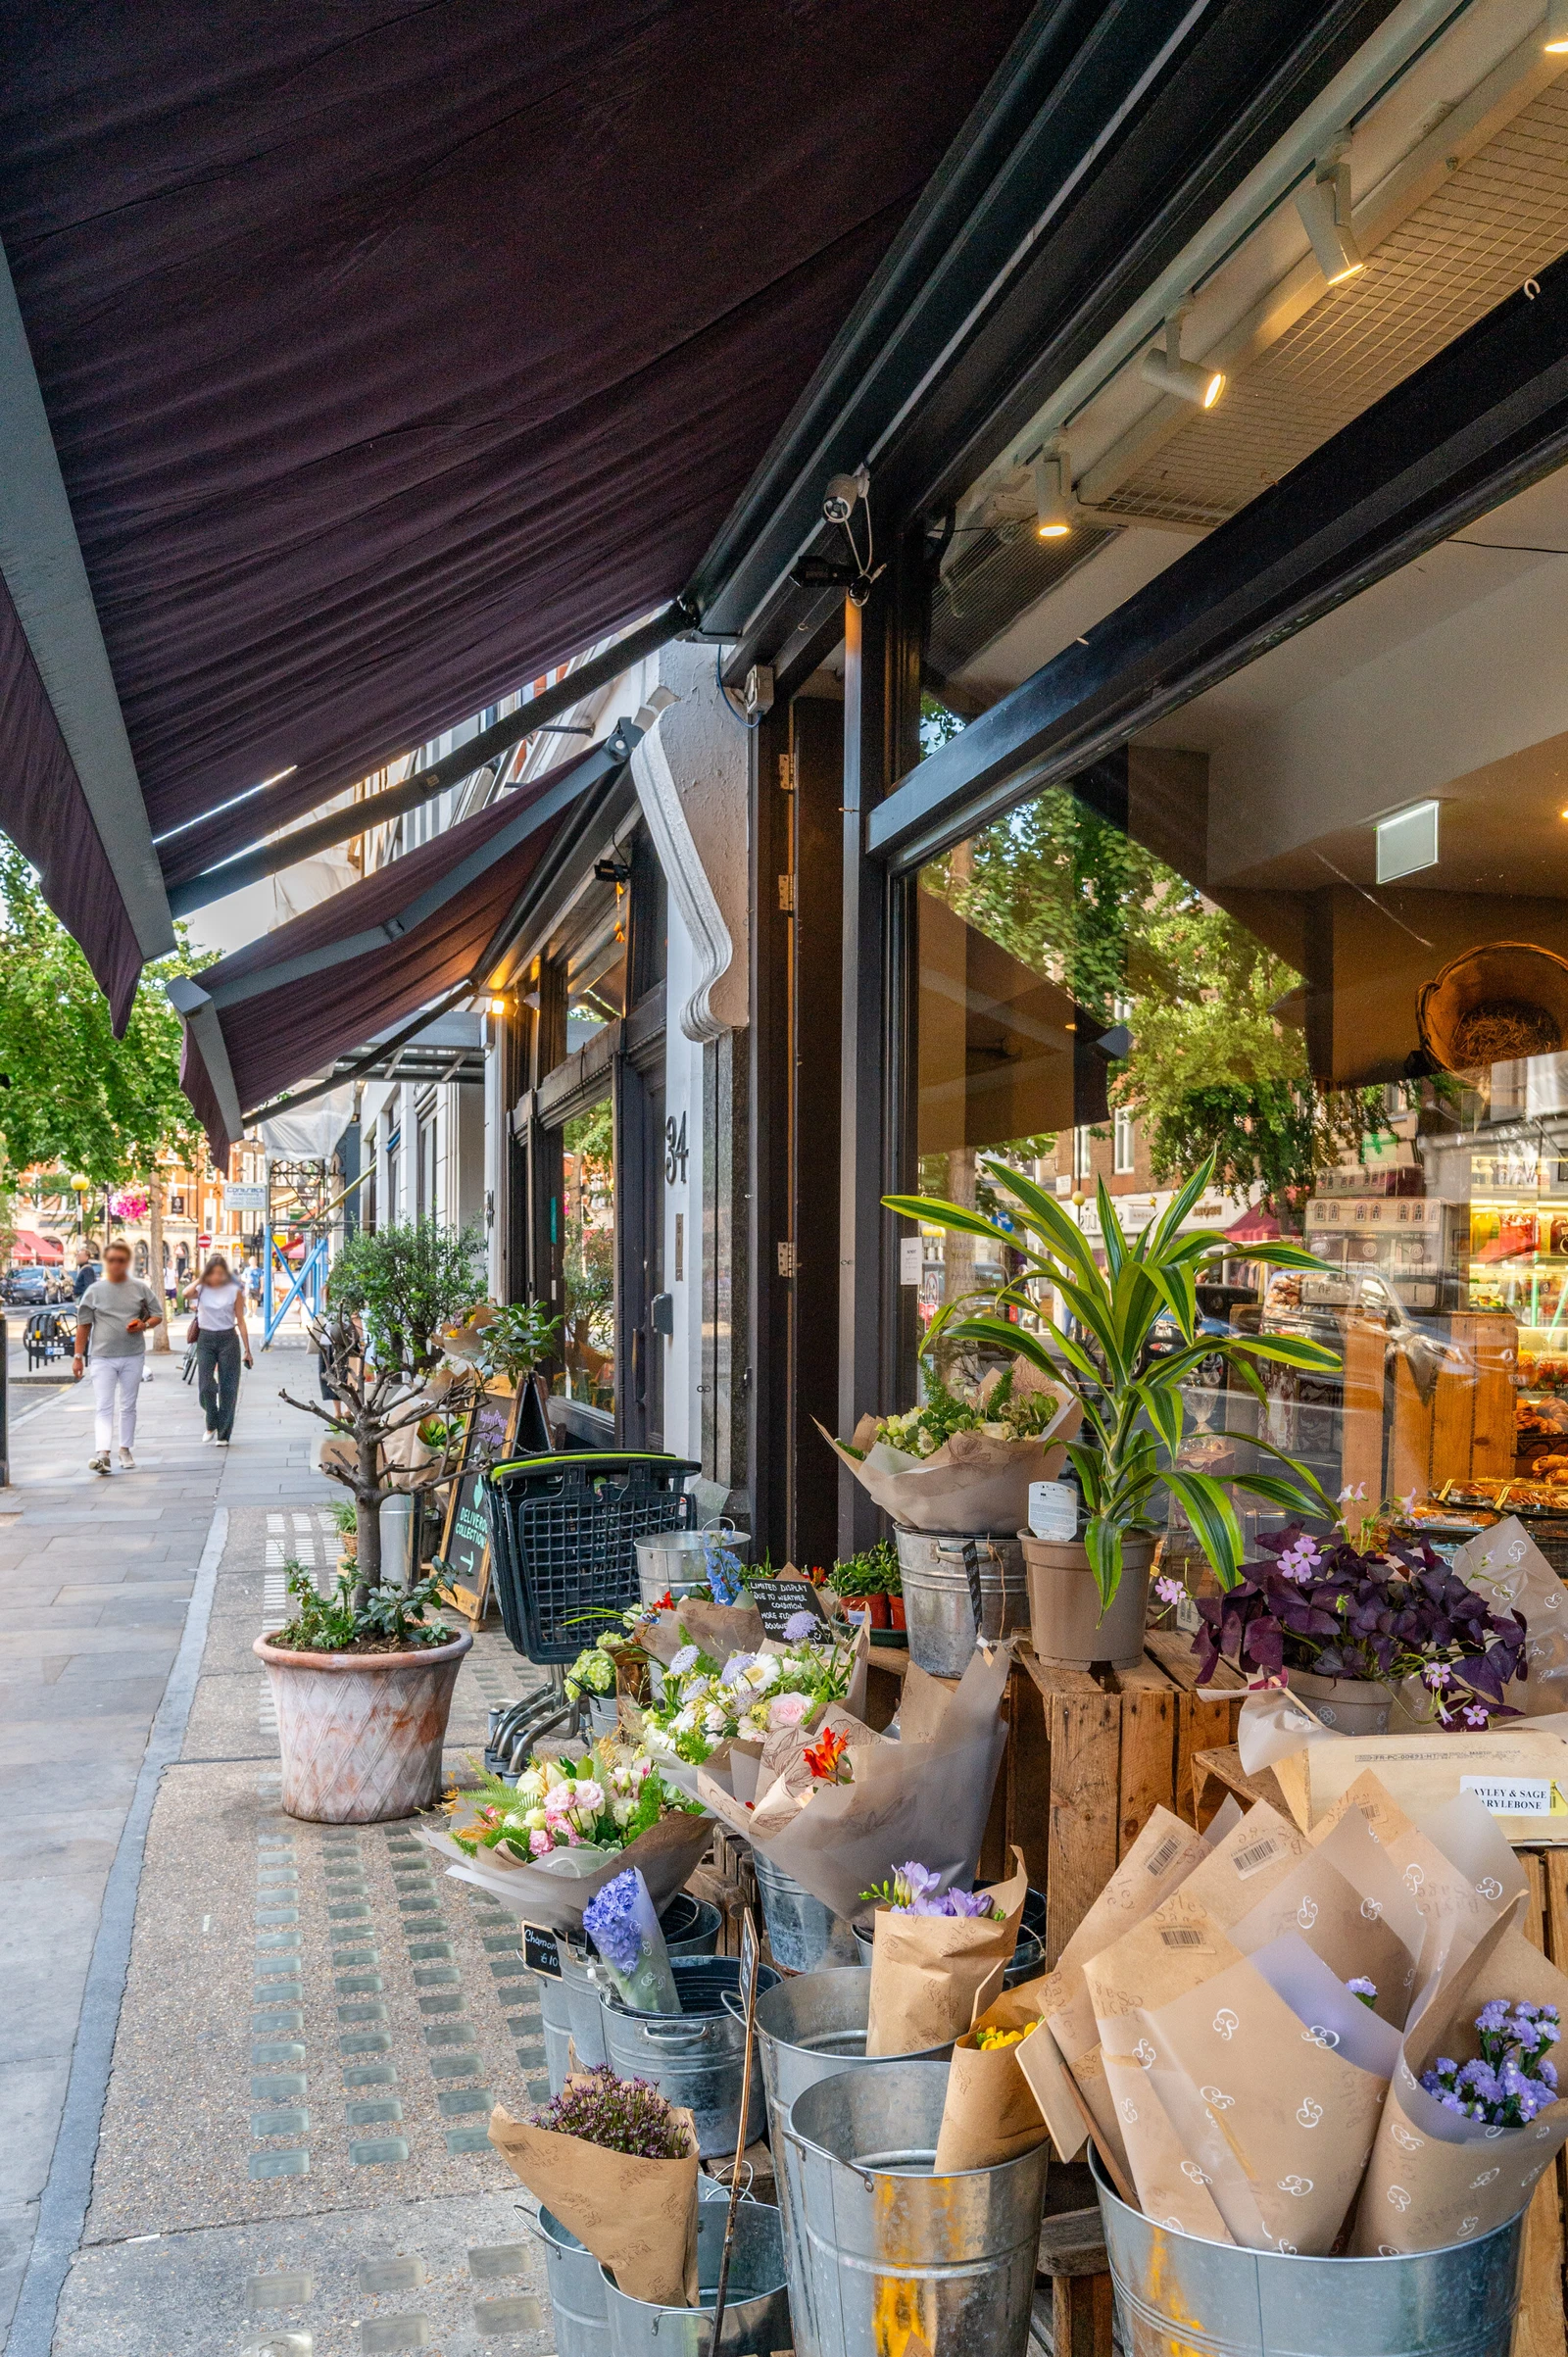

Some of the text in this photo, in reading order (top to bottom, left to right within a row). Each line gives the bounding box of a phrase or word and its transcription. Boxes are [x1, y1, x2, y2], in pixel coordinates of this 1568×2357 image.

[665, 1110, 689, 1185] 34
[750, 1582, 777, 1592] LIMITED
[754, 1592, 766, 1600] DUE
[1473, 1788, 1506, 1797] AYLEY
[1482, 1799, 1542, 1809] RYLEBONE
[541, 1952, 559, 1967] £10
